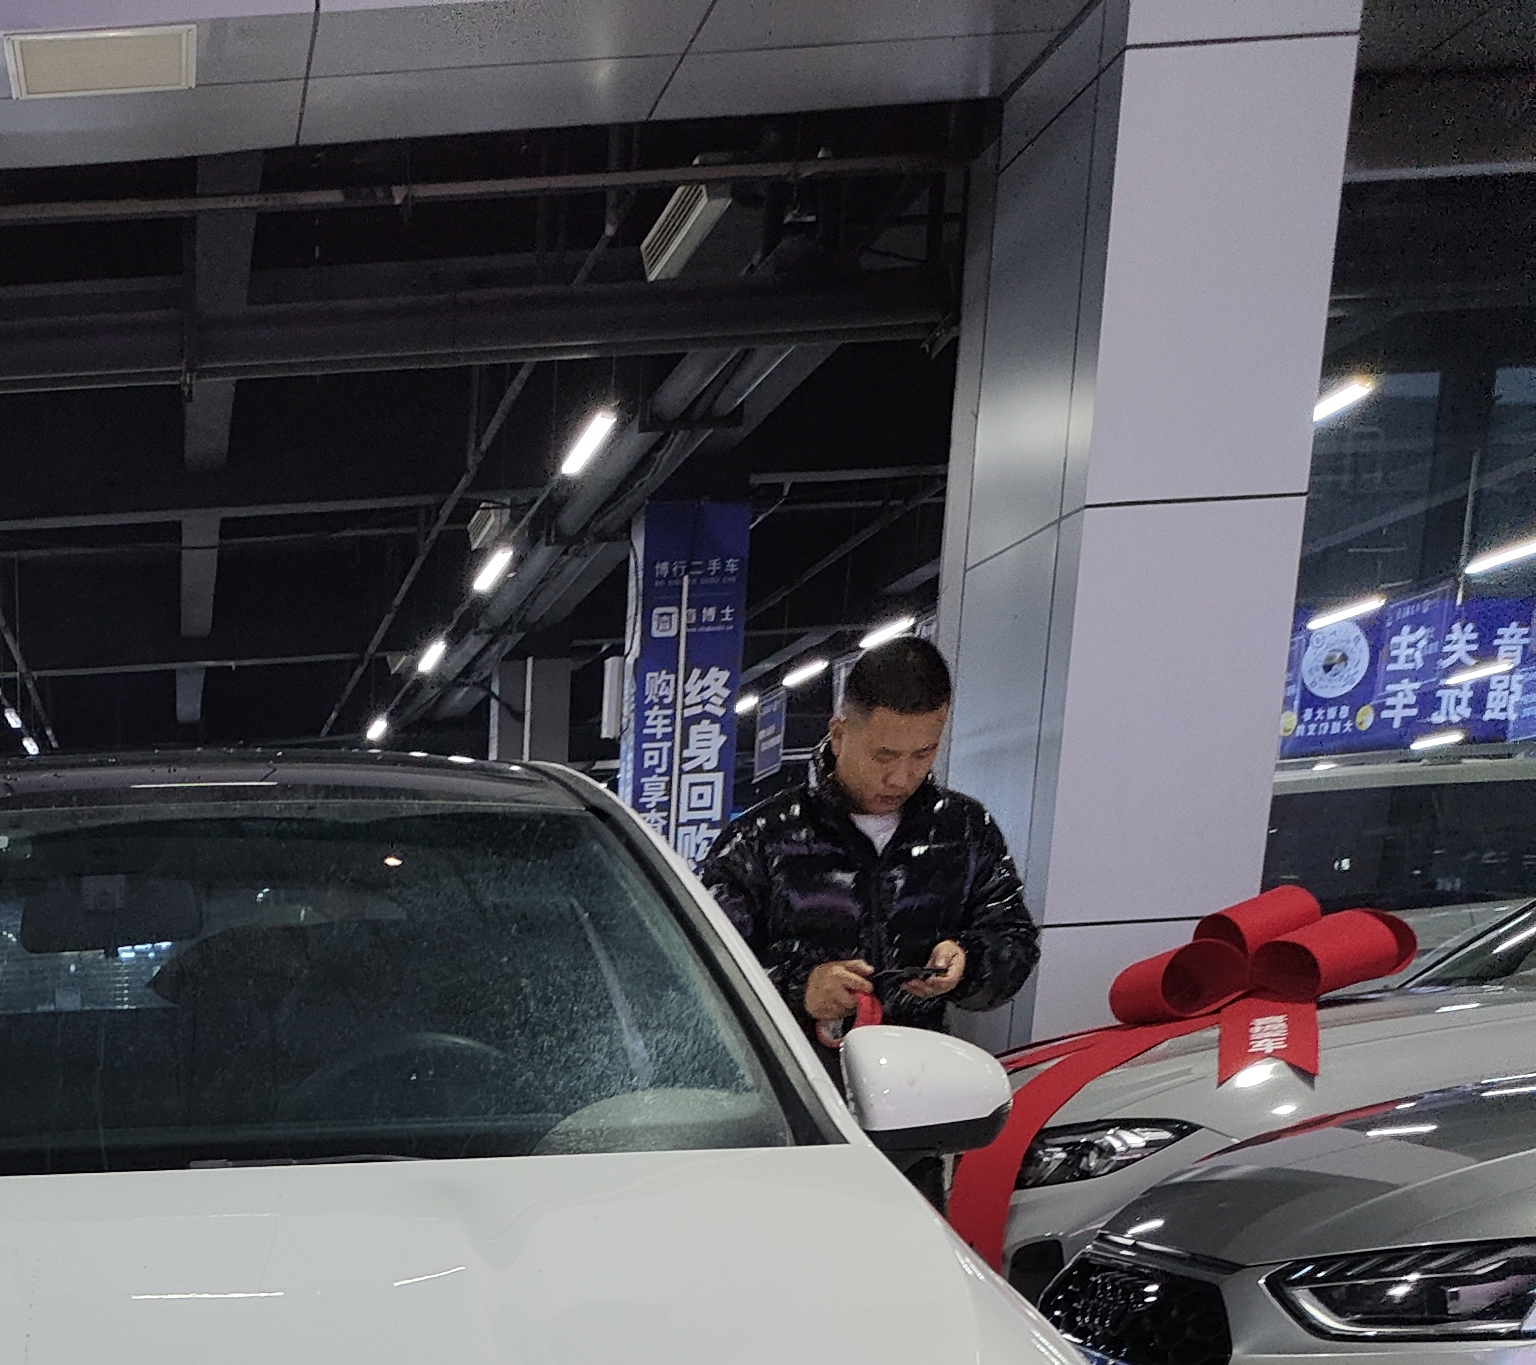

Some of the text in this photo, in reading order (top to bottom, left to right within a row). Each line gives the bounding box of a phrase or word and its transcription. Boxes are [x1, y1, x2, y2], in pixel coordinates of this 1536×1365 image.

[655, 558, 740, 577] 博行二手车
